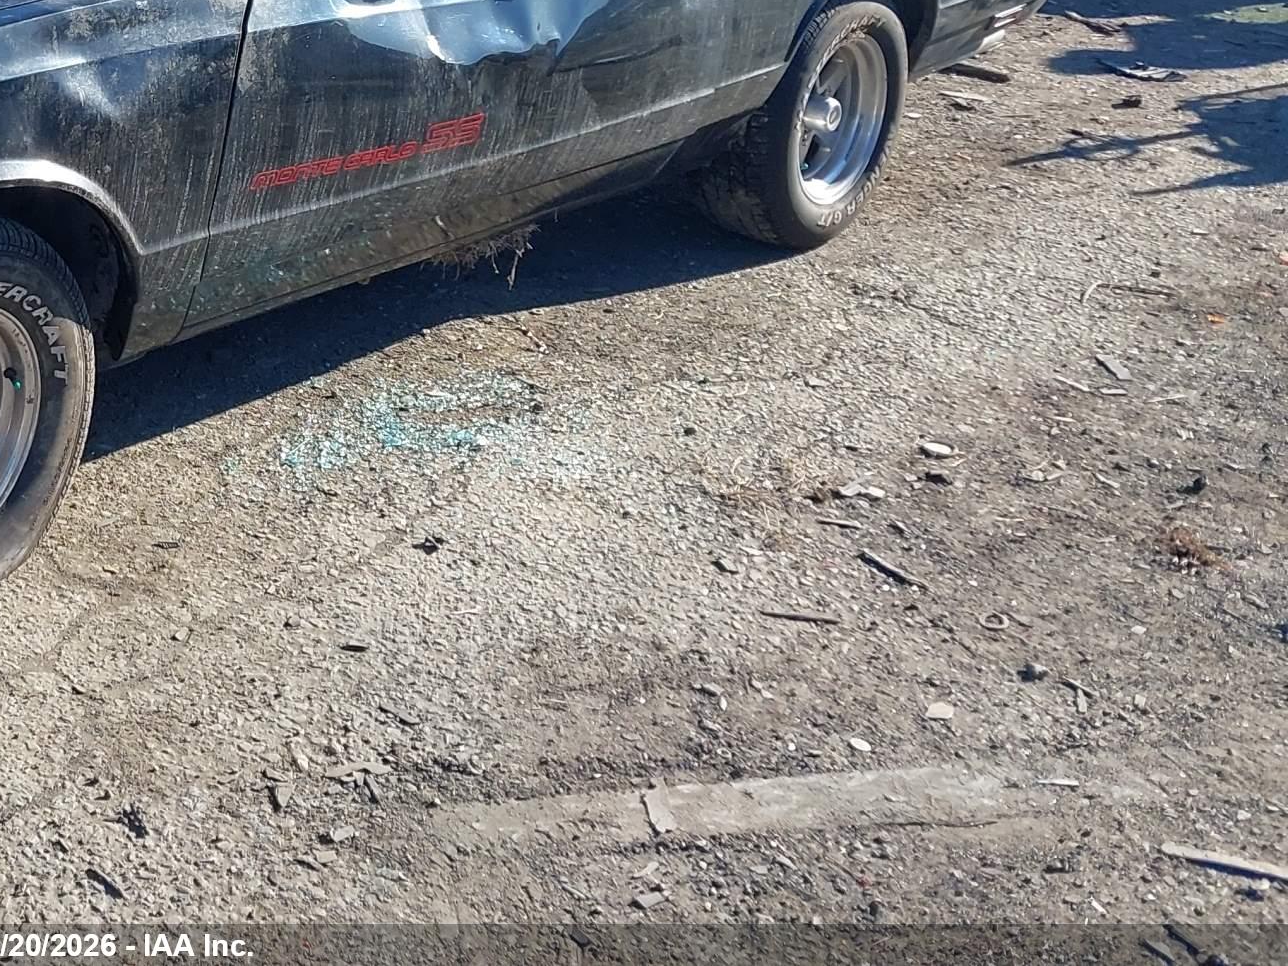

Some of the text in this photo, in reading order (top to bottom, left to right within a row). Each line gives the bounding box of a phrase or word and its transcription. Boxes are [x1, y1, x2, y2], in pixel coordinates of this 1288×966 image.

[248, 112, 487, 191] MONTE CARLO SS
